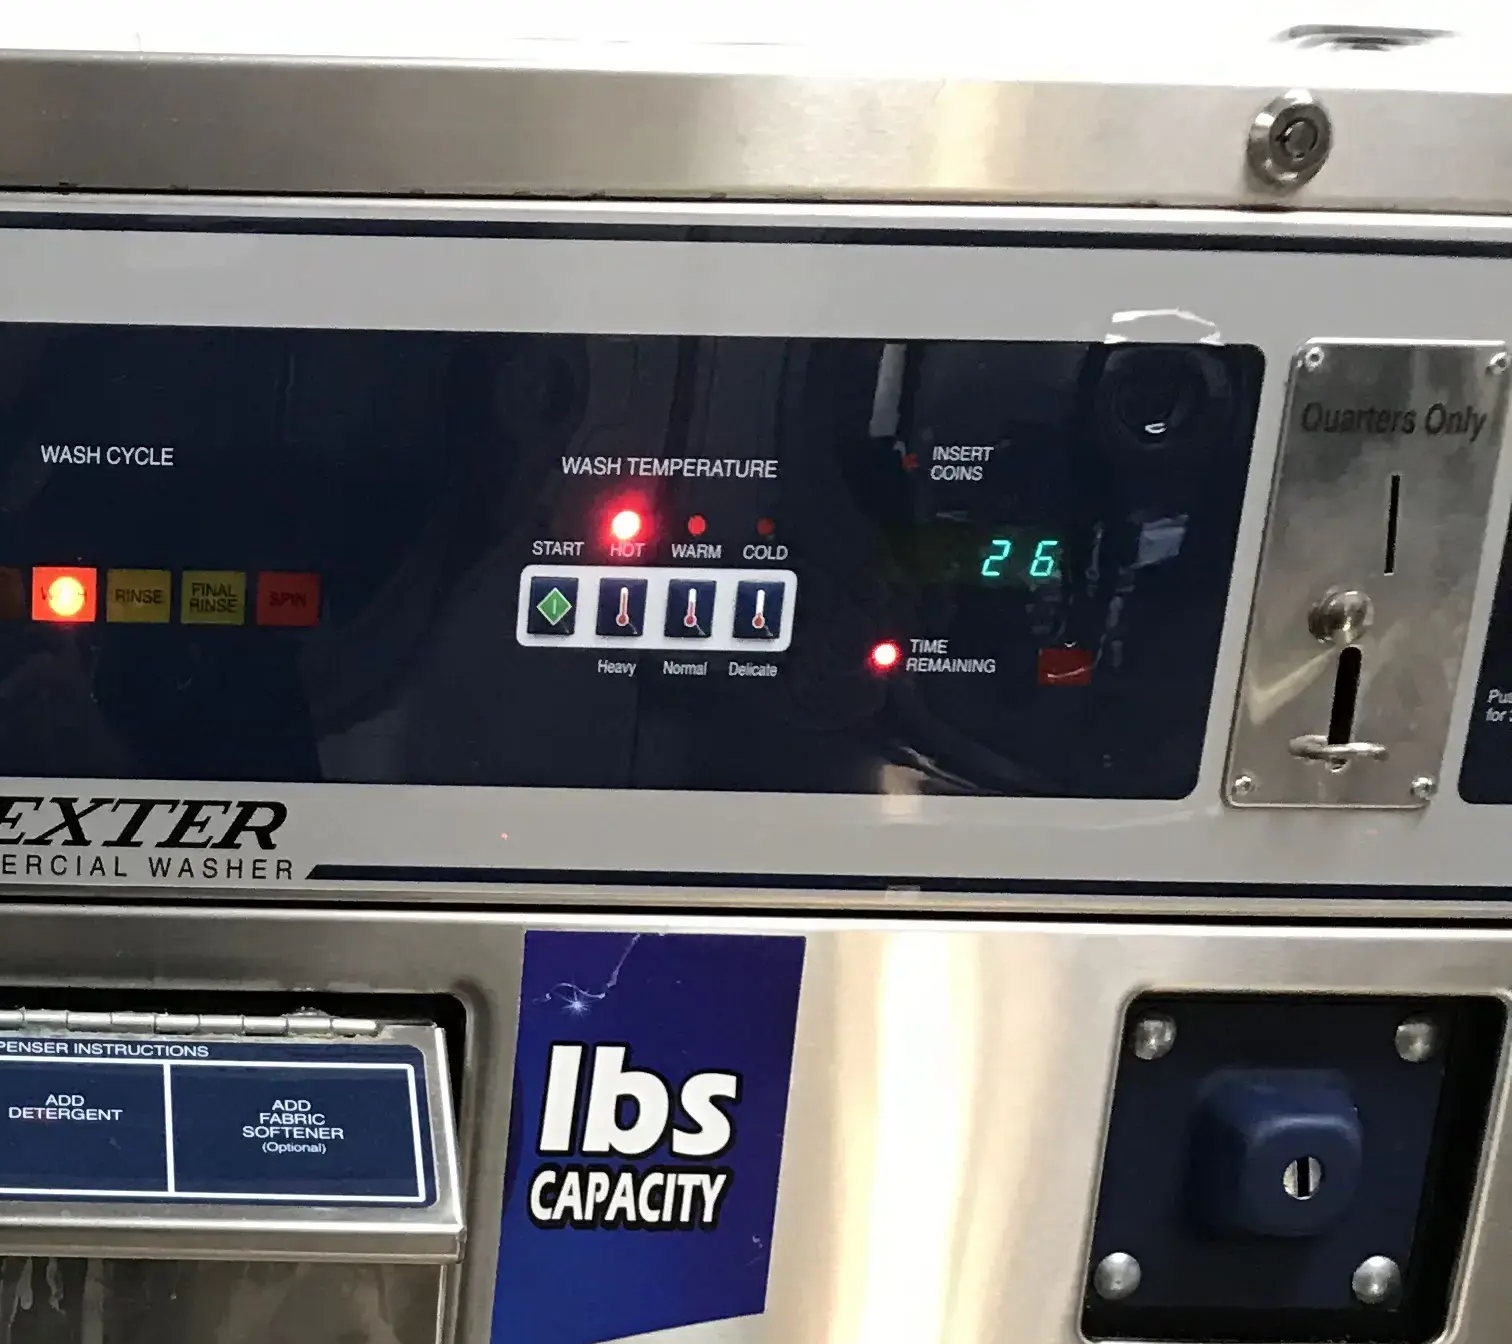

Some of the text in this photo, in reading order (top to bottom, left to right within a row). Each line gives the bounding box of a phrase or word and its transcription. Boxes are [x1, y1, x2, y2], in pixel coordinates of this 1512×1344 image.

[1301, 401, 1487, 443] Quarters Only
[40, 444, 174, 466] WASH CYCLE
[932, 445, 995, 462] INSERT
[561, 456, 779, 479] WASH TEMPERATURE
[930, 464, 983, 482] COINS
[531, 540, 585, 557] START
[609, 542, 646, 558] HOT
[671, 543, 722, 559] WARM
[742, 544, 789, 561] COLD
[114, 588, 165, 604] RINSE
[190, 583, 238, 597] FINAL
[188, 598, 239, 614] RINSE
[909, 638, 949, 655] TIME
[597, 658, 637, 678] Heavy
[662, 660, 708, 676] Normal
[728, 661, 778, 678] Delicate
[905, 657, 996, 674] REMAINING
[148, 856, 293, 880] WASHER
[73, 1042, 210, 1058] INSTRUCTIONS
[45, 1093, 85, 1107] ADD
[271, 1099, 312, 1112] ADD
[539, 1045, 737, 1156] lbs
[8, 1106, 123, 1121] DETERGENT
[259, 1112, 326, 1126] FABRIC
[242, 1125, 345, 1140] SOFTENER
[261, 1141, 327, 1155] (Optional)
[530, 1169, 727, 1223] CAPACITY
